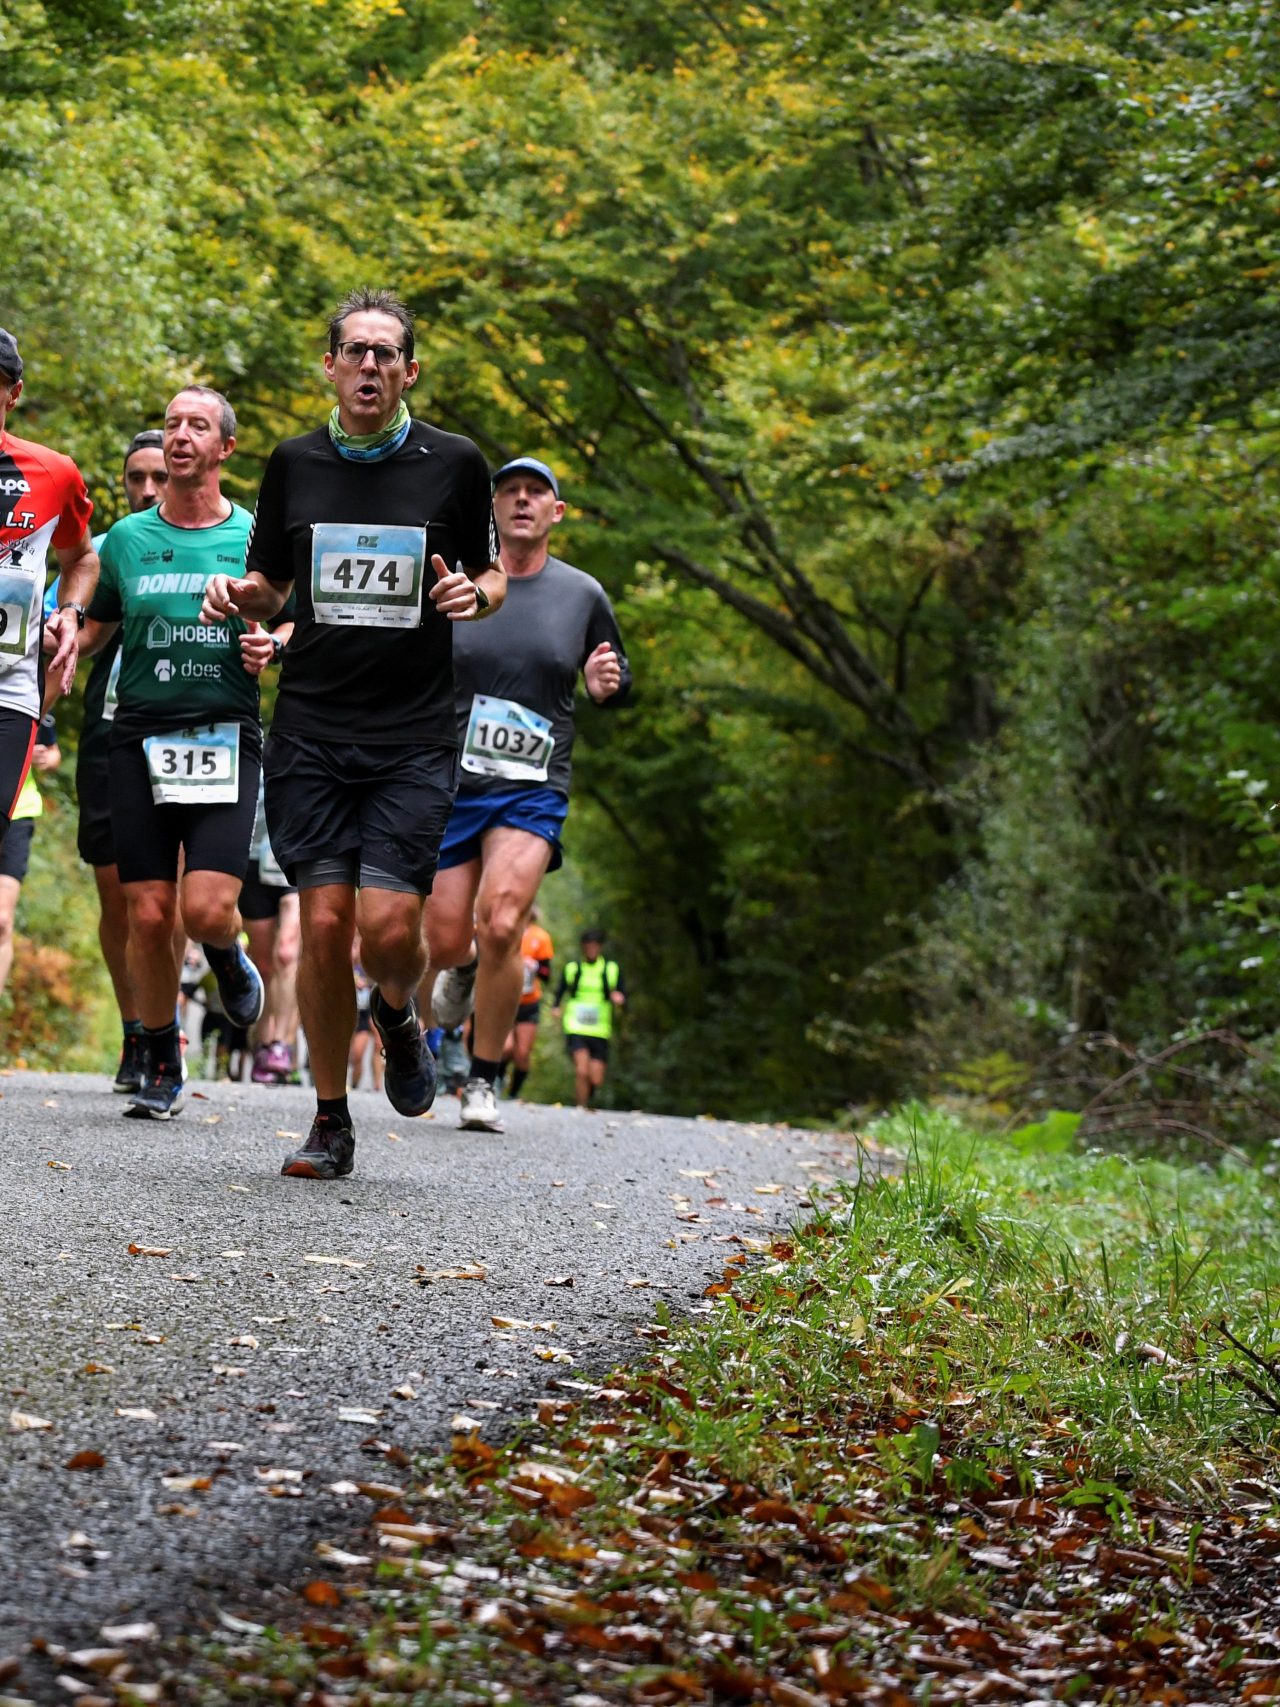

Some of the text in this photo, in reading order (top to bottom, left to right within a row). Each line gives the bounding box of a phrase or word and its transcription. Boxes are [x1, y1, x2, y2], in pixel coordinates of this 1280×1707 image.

[333, 558, 400, 591] 474
[173, 625, 230, 643] HOBEKI
[181, 659, 221, 678] does
[479, 723, 544, 756] 1037
[162, 748, 217, 776] 315
